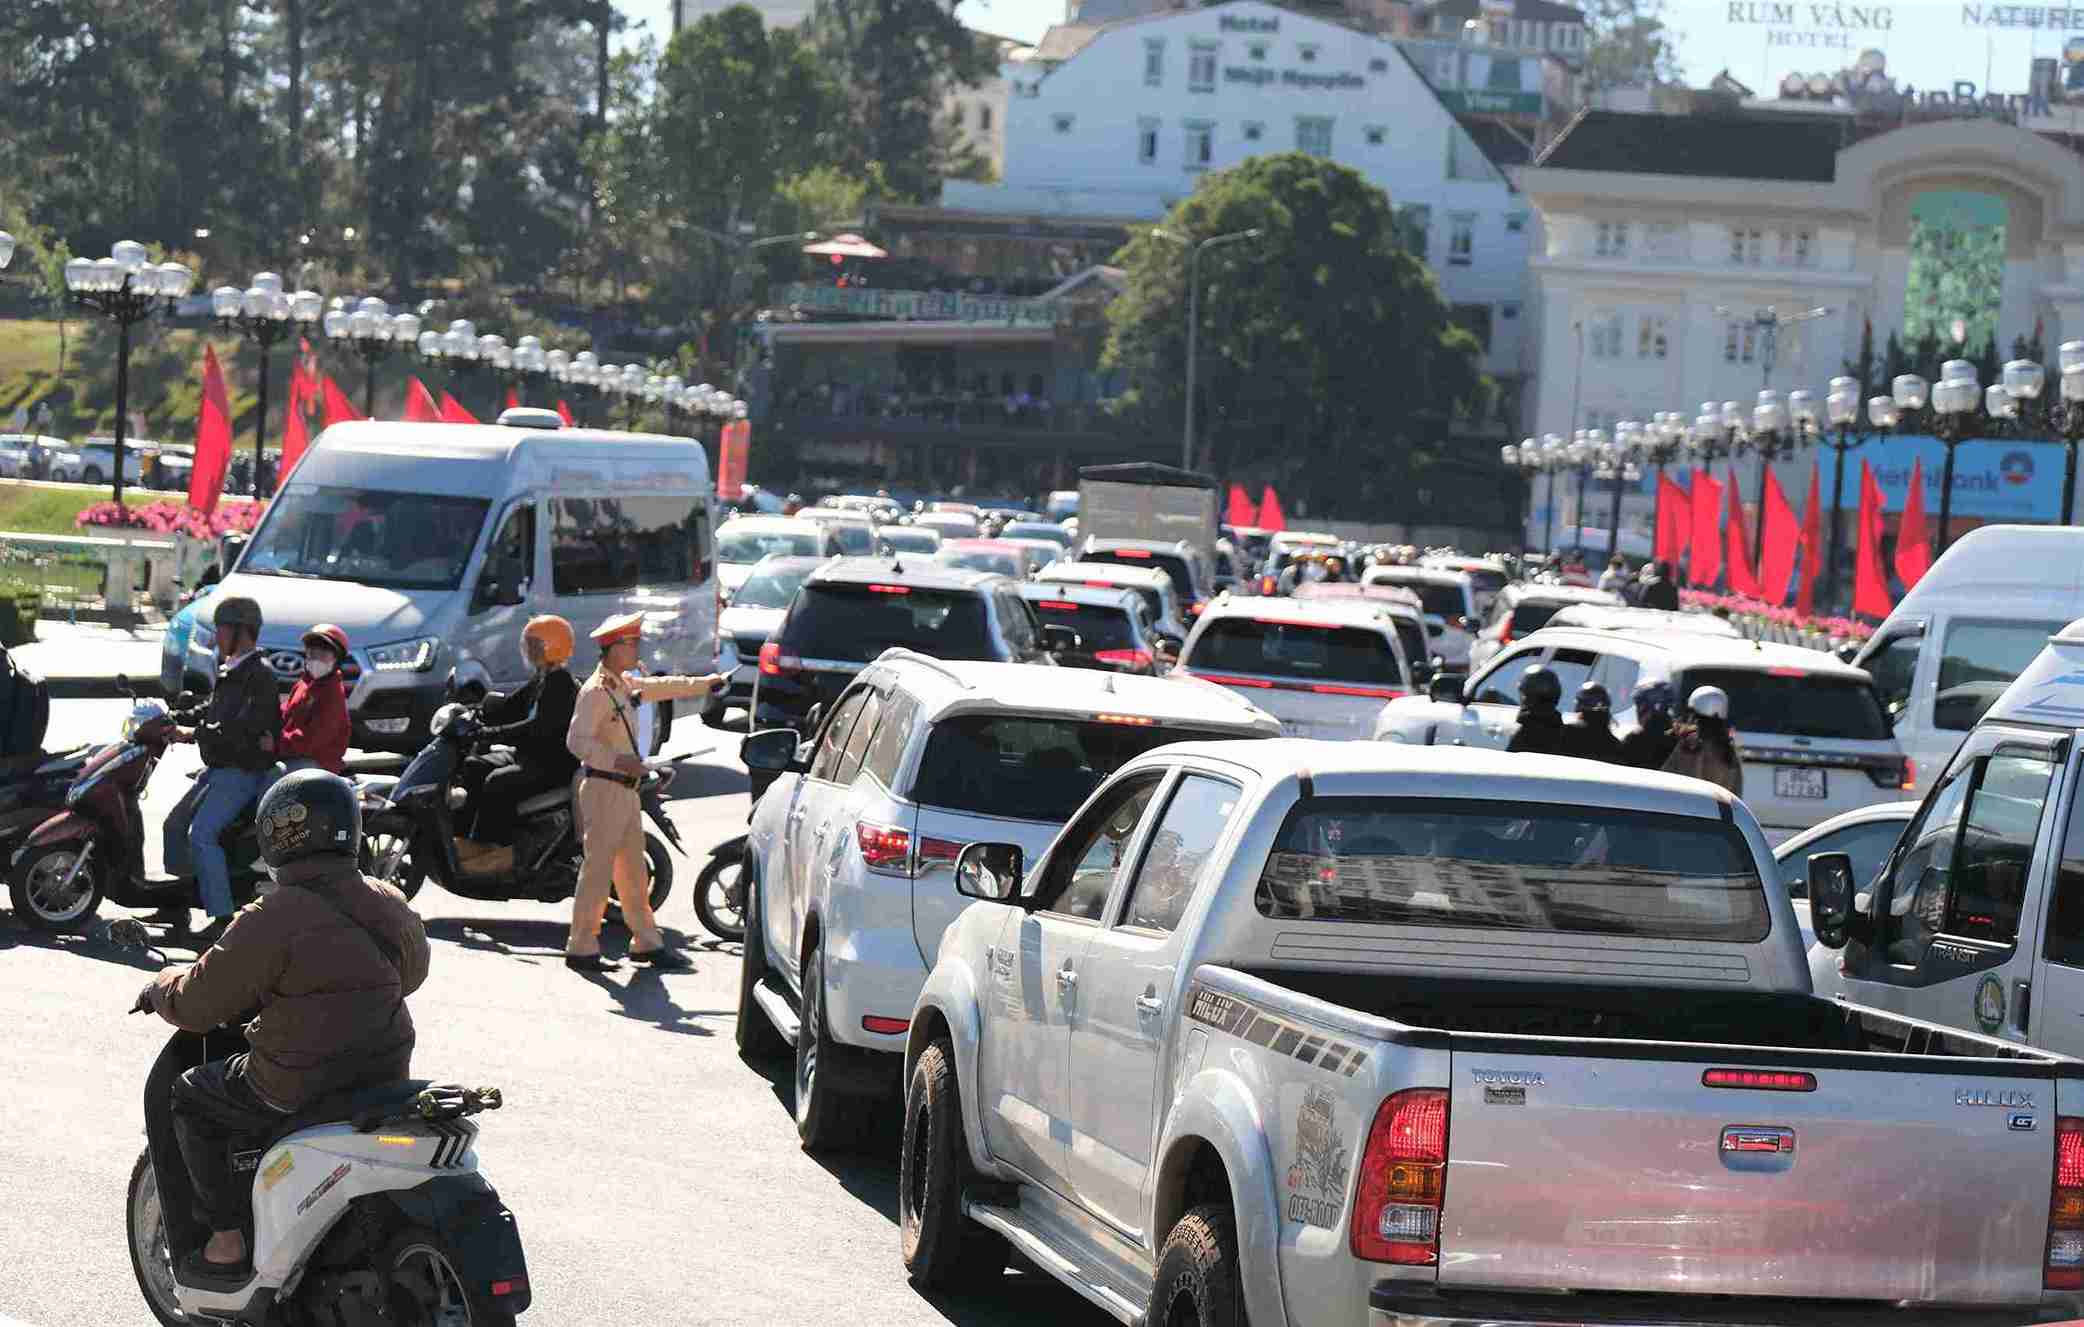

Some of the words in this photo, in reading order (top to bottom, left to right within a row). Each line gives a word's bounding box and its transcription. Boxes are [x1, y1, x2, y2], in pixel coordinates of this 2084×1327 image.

[1727, 1, 1793, 24] RUM
[1218, 15, 1279, 32] Hotel
[1767, 30, 1853, 48] HOTEL
[1471, 1070, 1545, 1086] TOYOTA
[1954, 1089, 2036, 1108] HILUX
